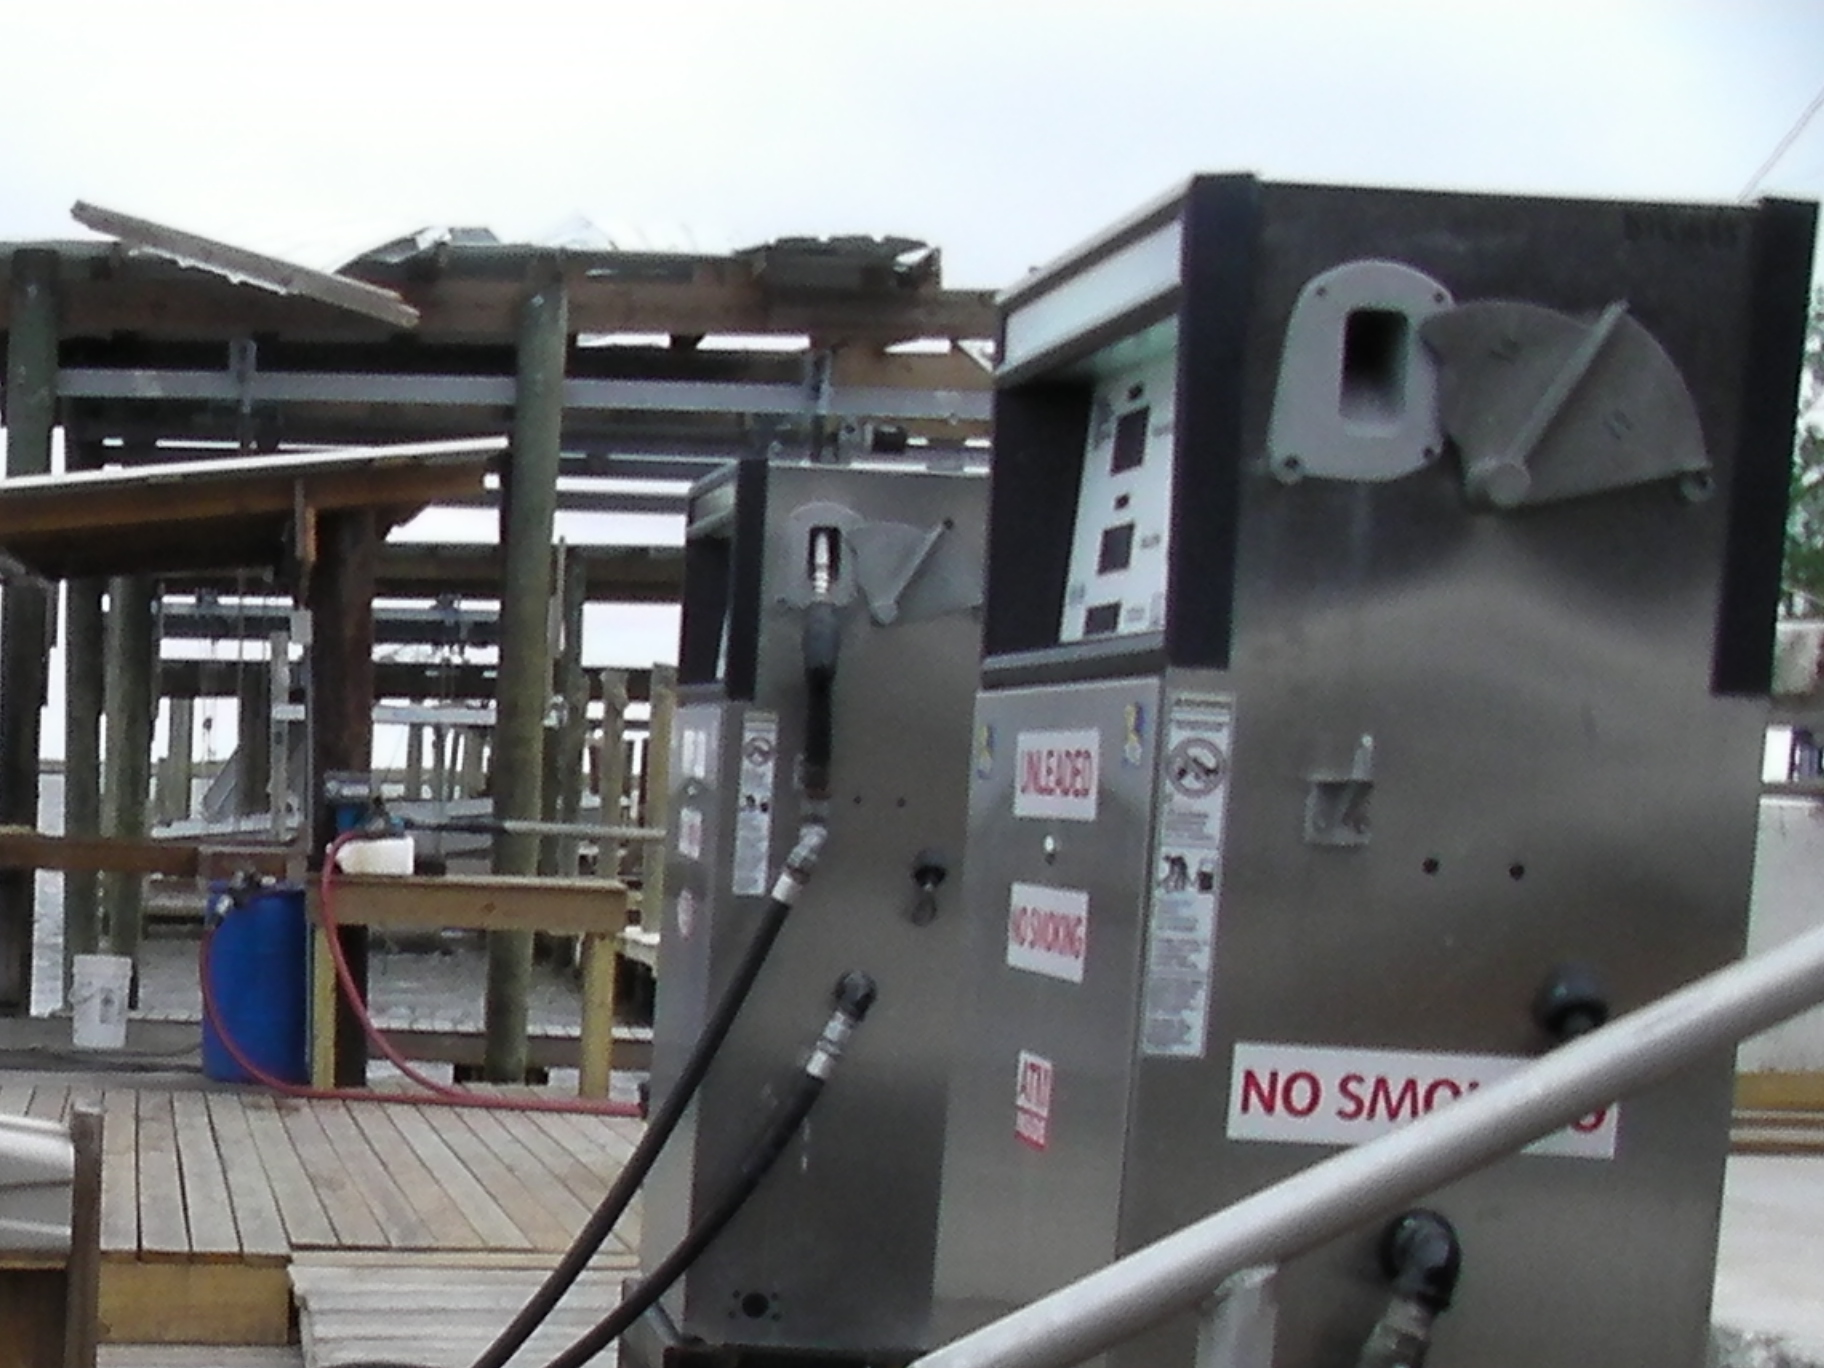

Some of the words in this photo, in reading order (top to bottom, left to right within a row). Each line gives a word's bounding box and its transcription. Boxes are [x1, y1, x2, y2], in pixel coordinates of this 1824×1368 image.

[1020, 749, 1092, 798] UNLEADED
[1029, 908, 1084, 959] SMOKING
[1241, 1069, 1322, 1117] NO
